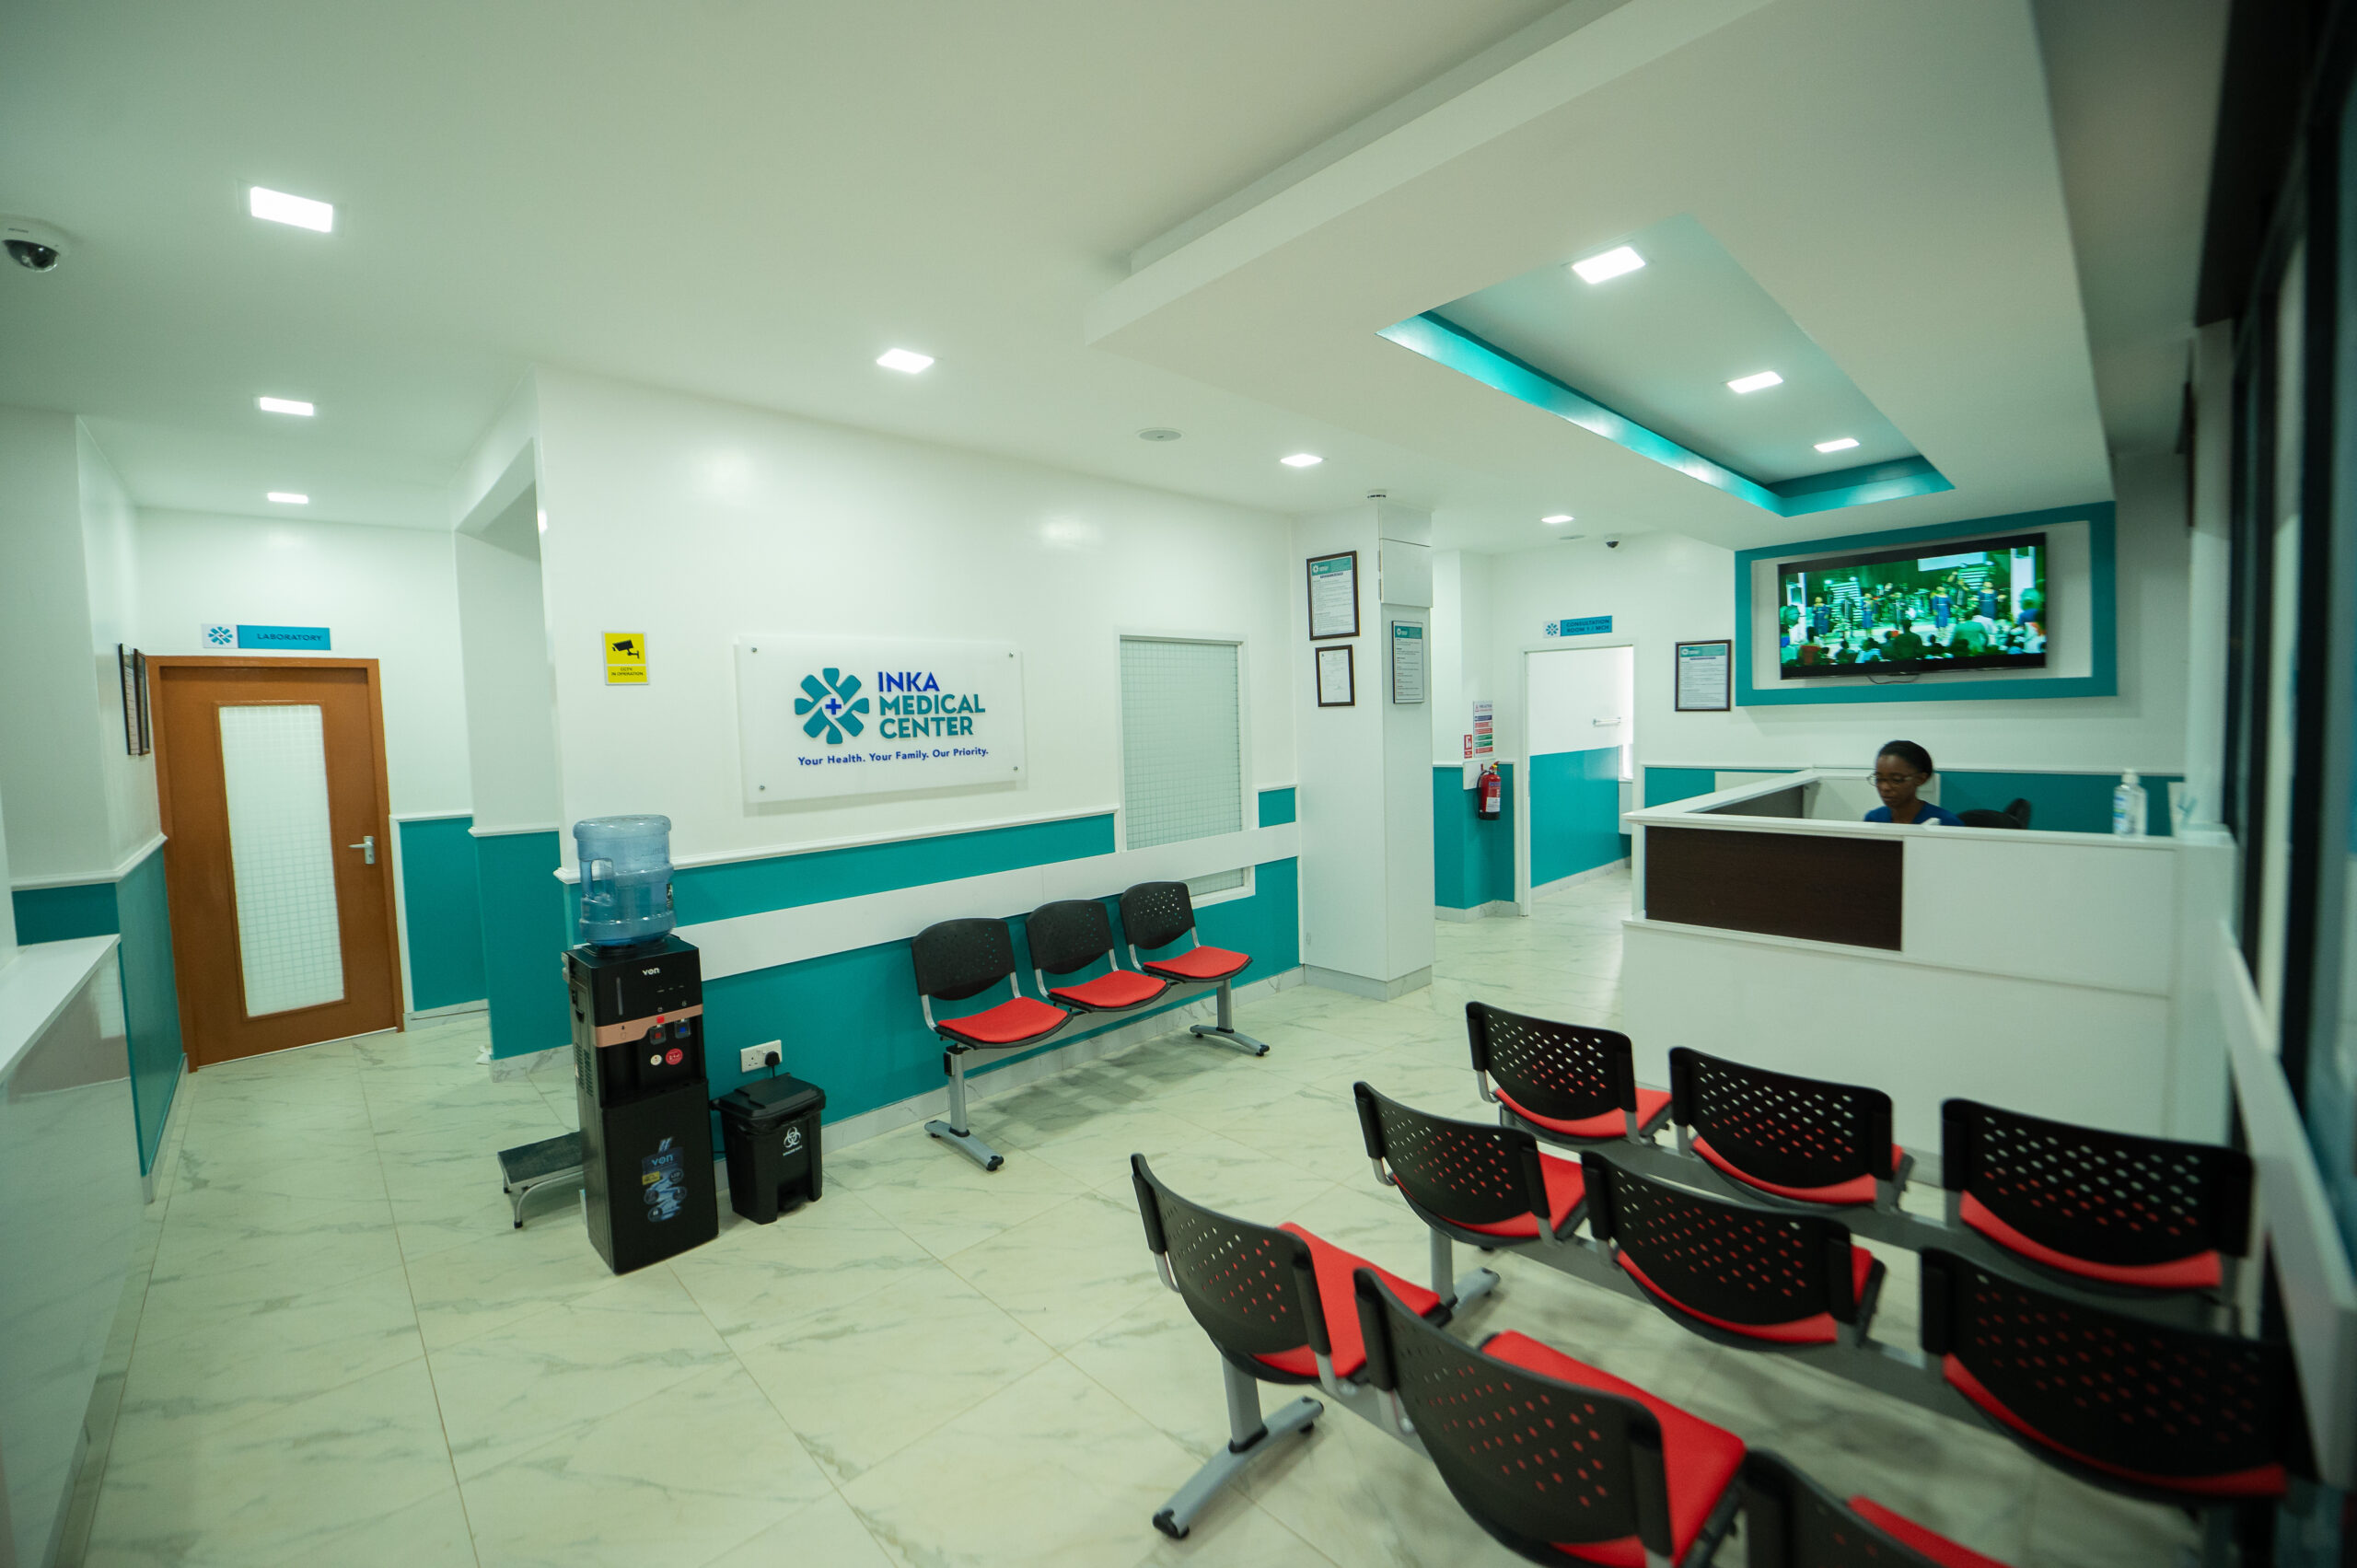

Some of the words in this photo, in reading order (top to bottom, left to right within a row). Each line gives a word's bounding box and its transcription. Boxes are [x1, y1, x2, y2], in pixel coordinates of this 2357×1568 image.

[1566, 619, 1609, 627] CONSULTATION
[257, 633, 322, 642] LABORATORY
[877, 671, 940, 692] INKA
[879, 693, 986, 716] MEDICAL
[879, 716, 974, 739] CENTER
[797, 756, 823, 766] Your
[827, 753, 866, 764] Health.
[869, 752, 892, 762] Your
[896, 749, 929, 761] Family.
[932, 749, 949, 758] Our
[953, 747, 989, 757] Priority.
[642, 967, 660, 976] von
[651, 1154, 674, 1166] von
